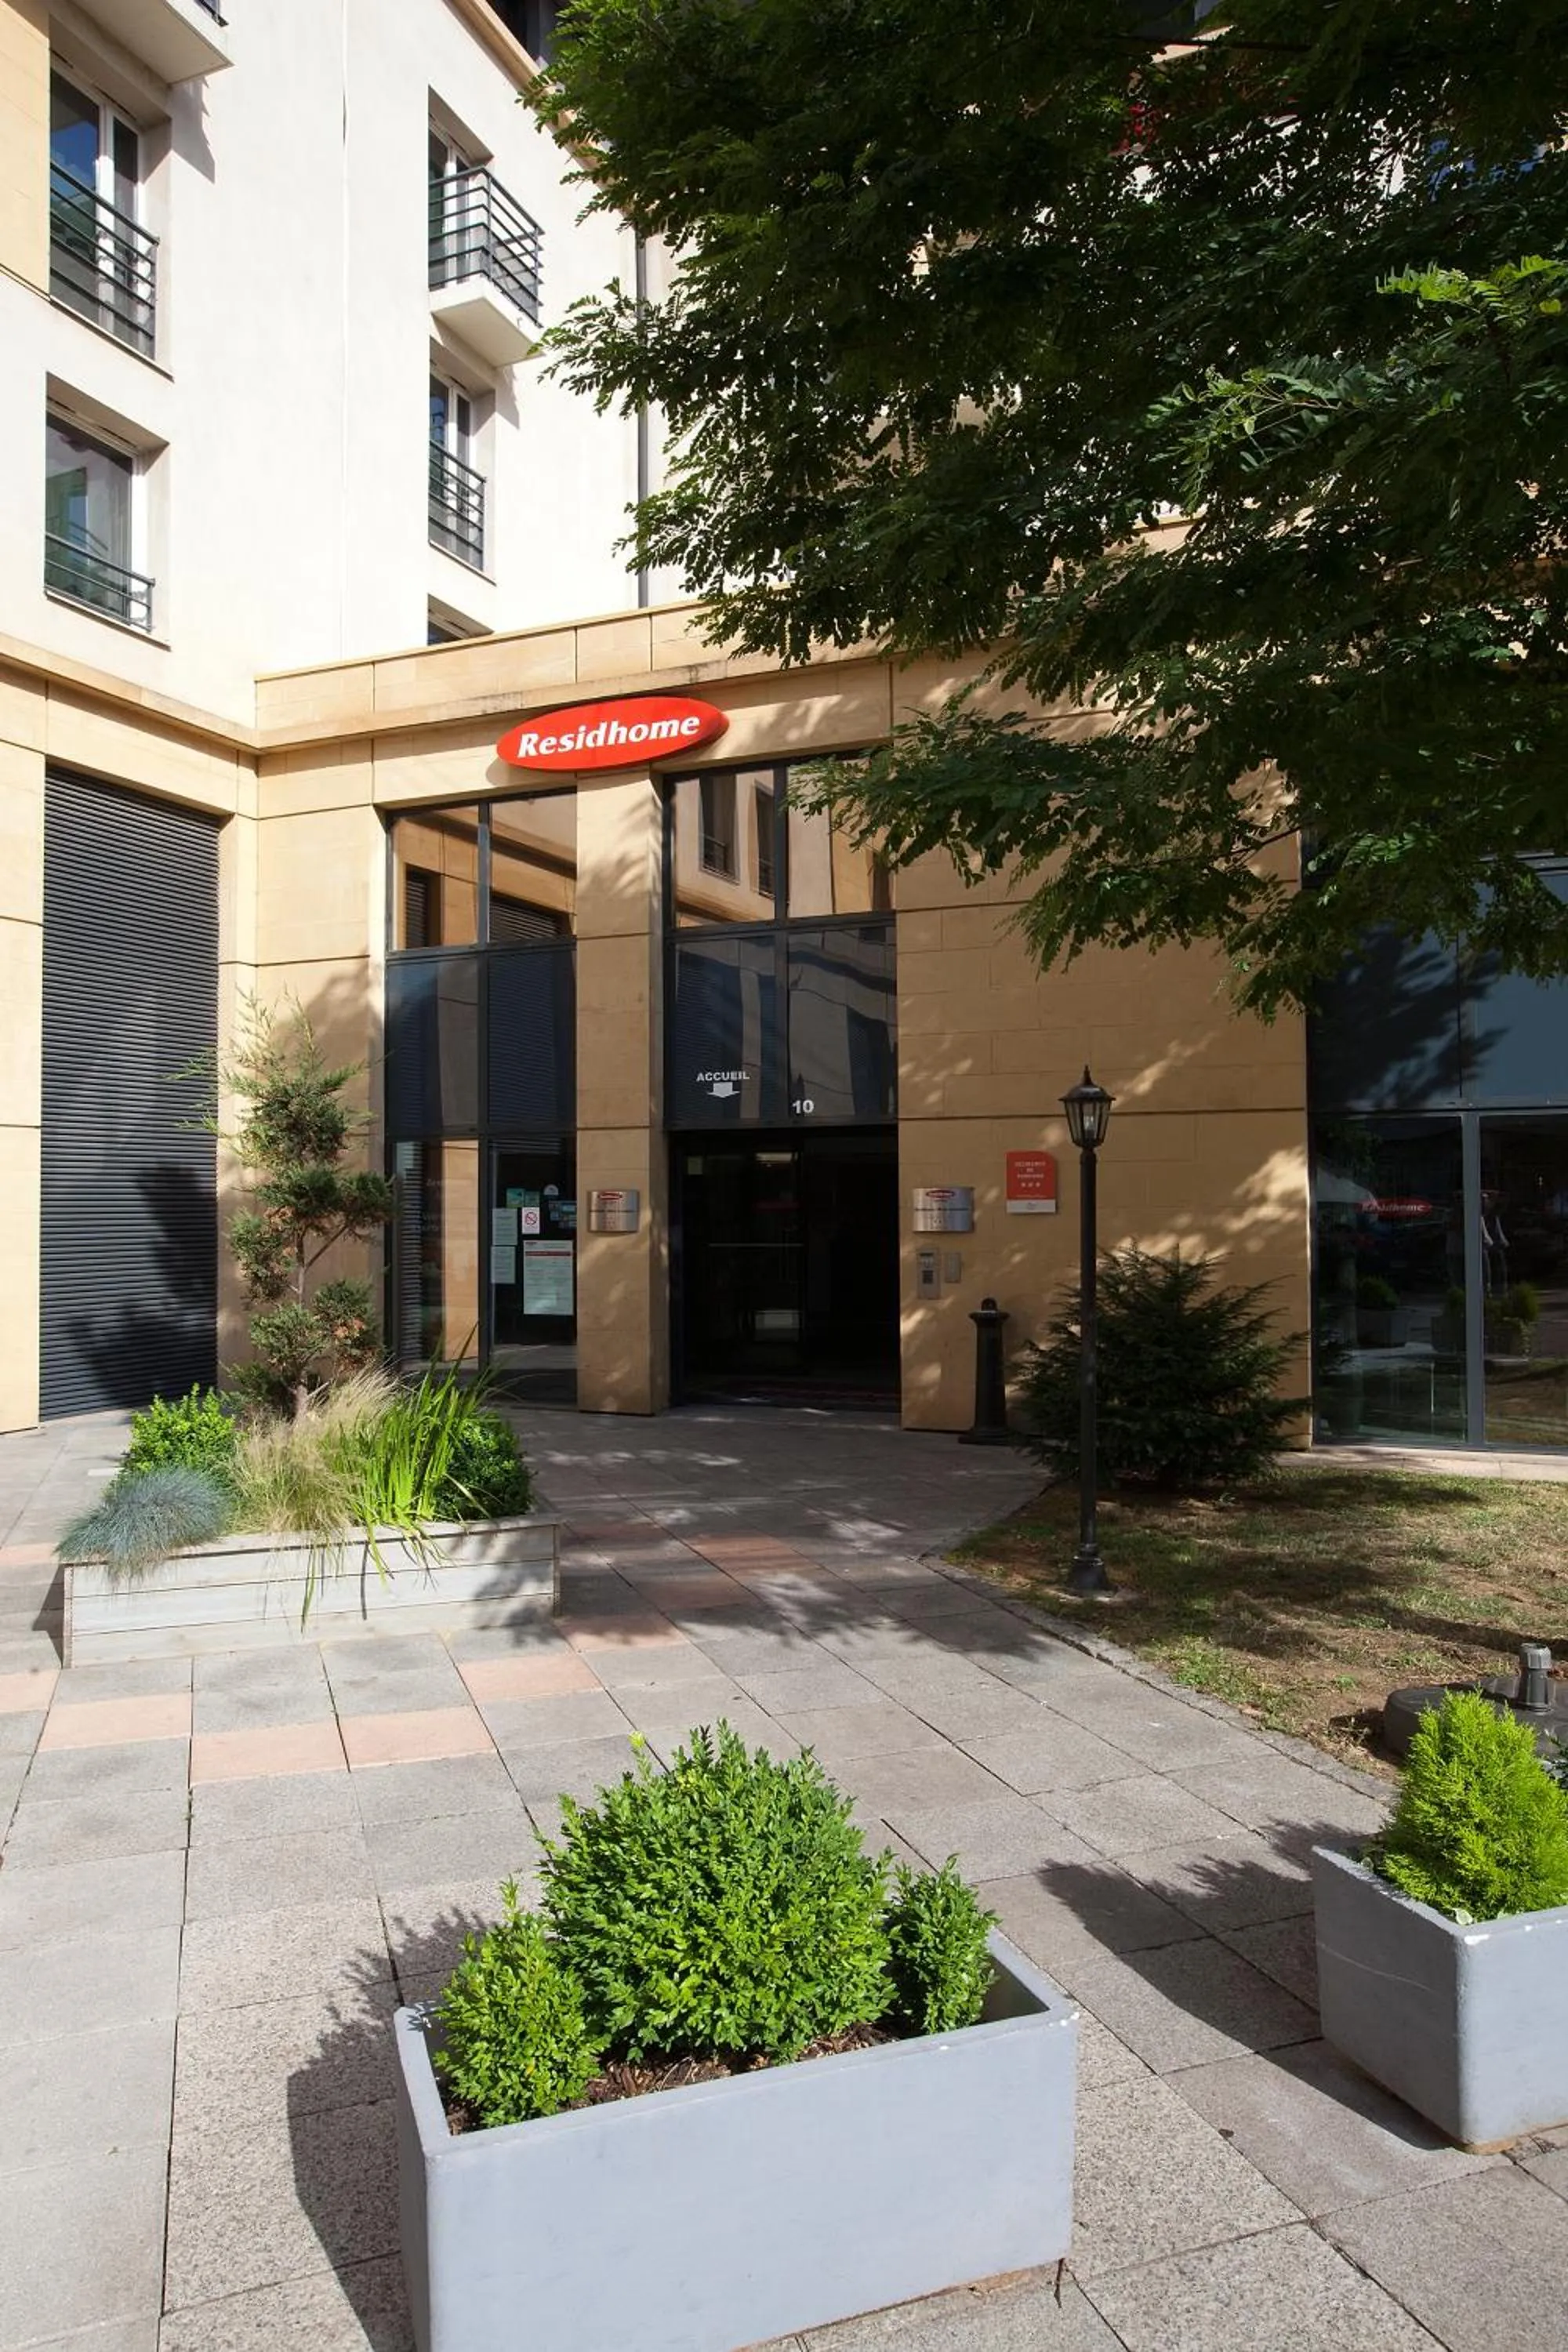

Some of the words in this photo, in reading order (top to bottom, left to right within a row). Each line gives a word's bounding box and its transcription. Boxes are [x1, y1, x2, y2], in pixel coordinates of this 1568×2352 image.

[517, 715, 701, 758] Residhome
[696, 1071, 750, 1081] ACCUEIL
[792, 1099, 815, 1114] 10
